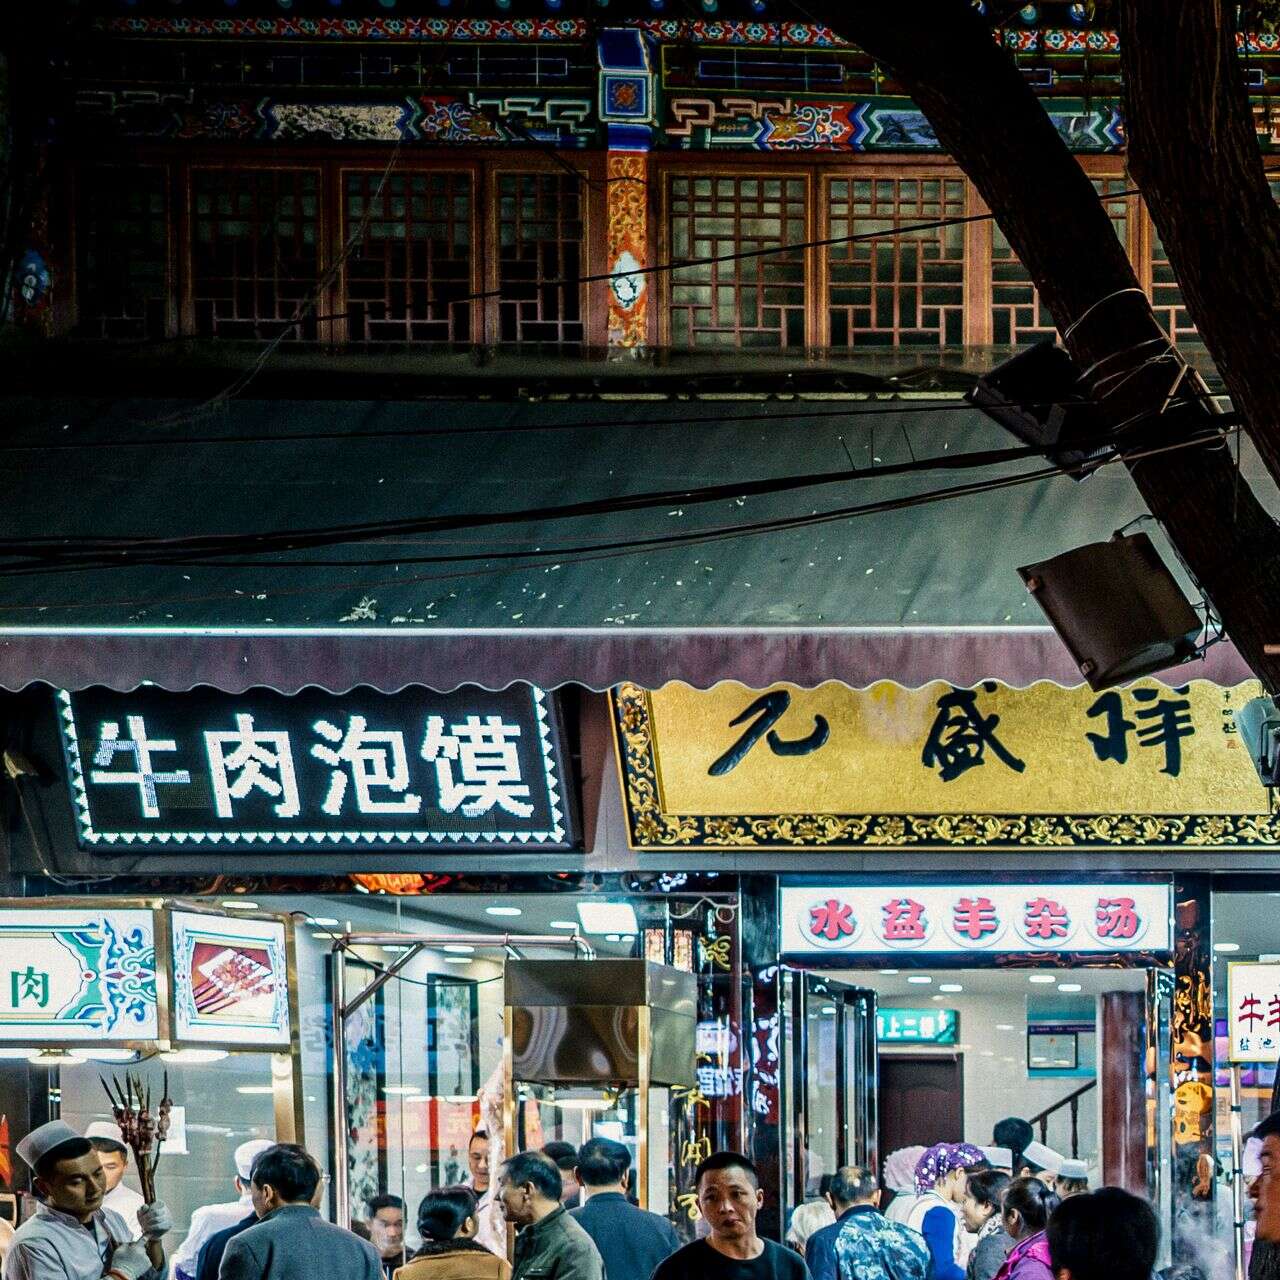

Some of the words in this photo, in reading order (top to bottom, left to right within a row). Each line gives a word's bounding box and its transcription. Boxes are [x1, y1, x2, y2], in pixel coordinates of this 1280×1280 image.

[91, 714, 534, 819] 牛肉泡馍
[808, 897, 1139, 941] 水盆羊杂汤
[11, 966, 49, 1008] 肉
